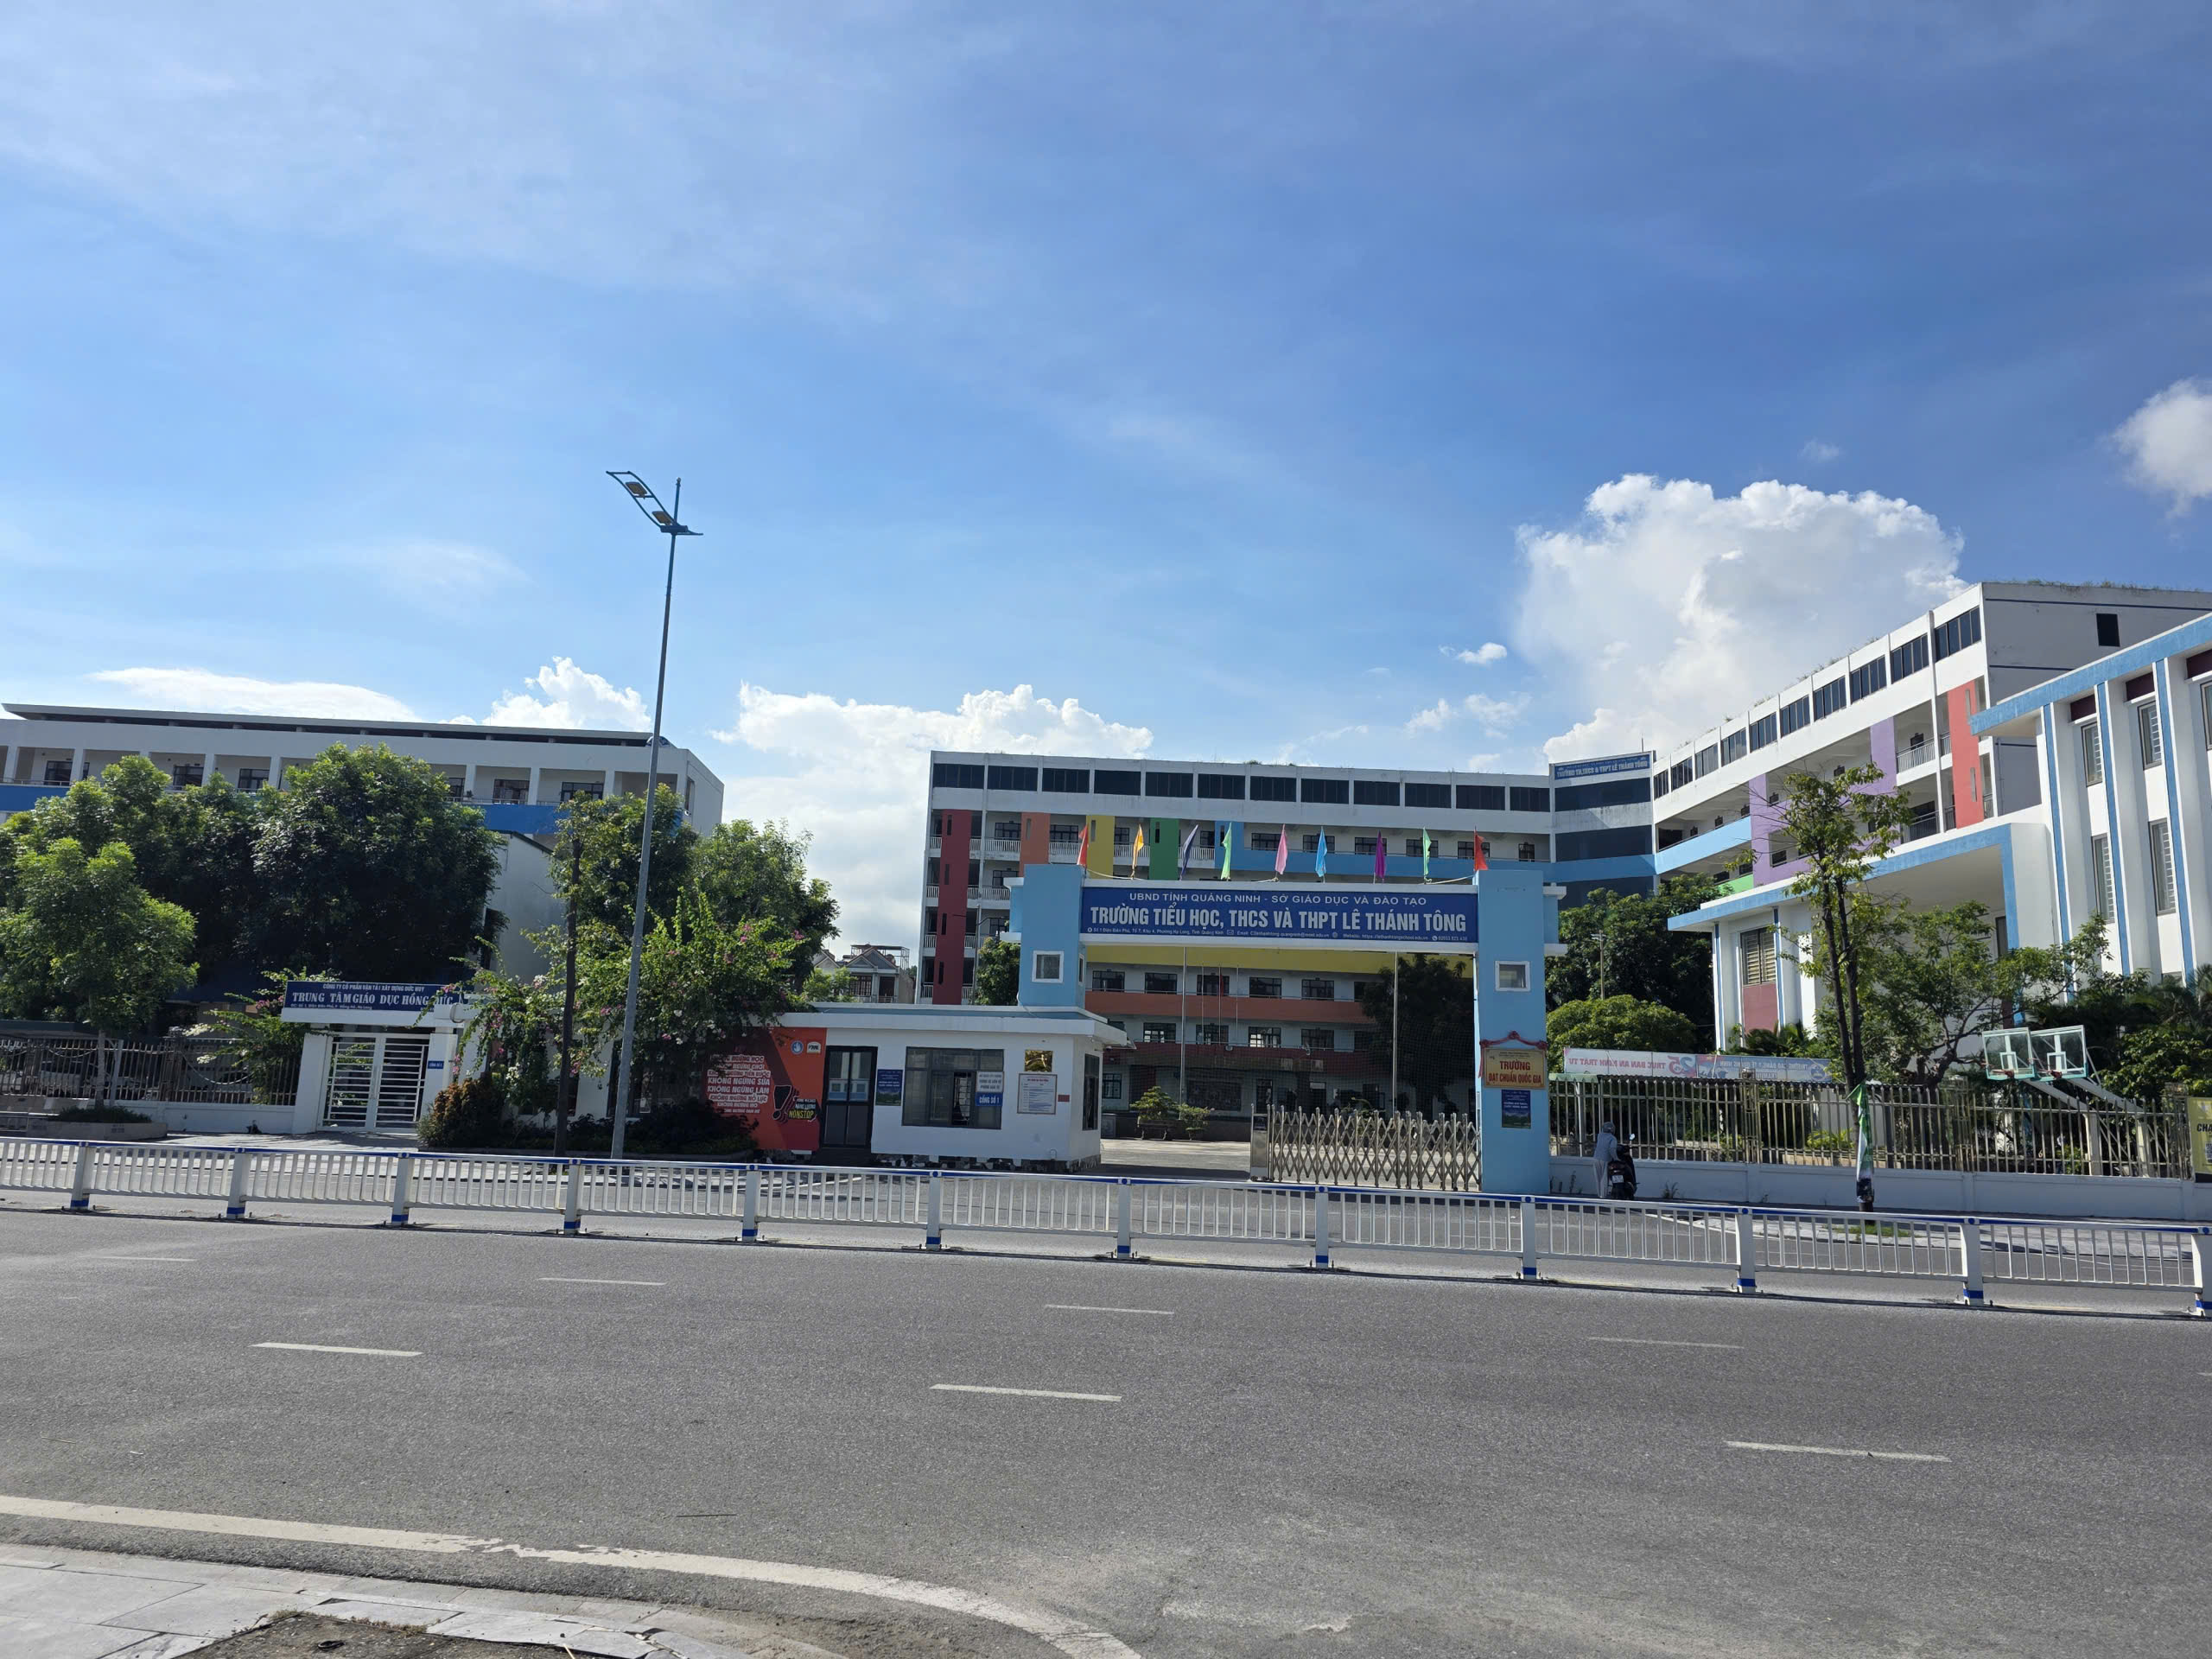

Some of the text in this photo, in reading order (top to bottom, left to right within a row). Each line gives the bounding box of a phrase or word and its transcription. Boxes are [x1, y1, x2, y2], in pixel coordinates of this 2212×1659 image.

[1129, 893, 1160, 901] UBND
[1162, 892, 1188, 902] TỈNH
[1191, 893, 1231, 902] QUẢNG
[1234, 894, 1261, 903] NINH
[1271, 893, 1288, 904] SỞ
[1292, 893, 1321, 904] GIÁO
[1325, 896, 1349, 906] DỤC
[1354, 895, 1369, 905] VÀ
[1373, 895, 1399, 905] ĐÀO
[1402, 897, 1427, 907] TẠO
[1090, 901, 1466, 931] TRƯỜNG TIỂU HỌC, THCS VÀ THPT LÊ THÁNH TÔNG
[292, 992, 325, 1002] TRUNG
[329, 991, 352, 1003] TÂM
[352, 992, 376, 1004] GIÁO
[379, 995, 399, 1006] DỤC
[1499, 1058, 1531, 1071] TRƯỜNG
[1488, 1070, 1542, 1084] ĐẠT CHUẨN QUỐC GIA
